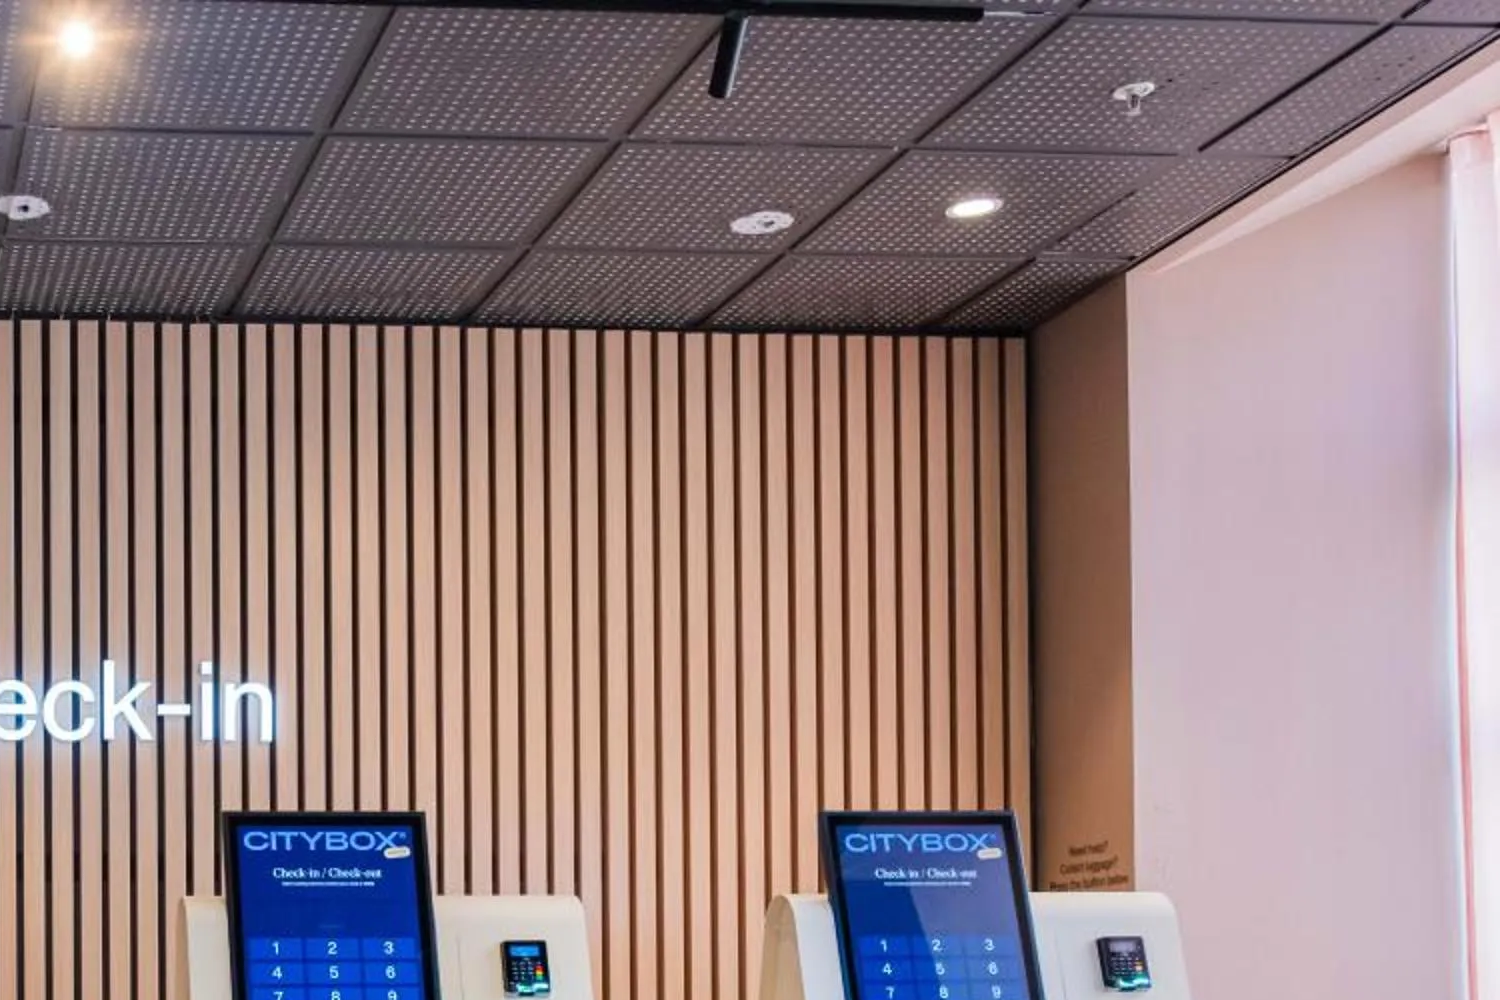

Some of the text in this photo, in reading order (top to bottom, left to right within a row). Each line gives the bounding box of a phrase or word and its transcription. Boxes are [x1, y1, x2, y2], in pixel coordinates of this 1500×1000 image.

[272, 941, 394, 955] 1 2 3
[880, 939, 995, 952] 1 2 3
[272, 966, 396, 979] 4 5 6
[882, 962, 998, 975] 4 5 6
[886, 985, 1001, 999] 7 8 9
